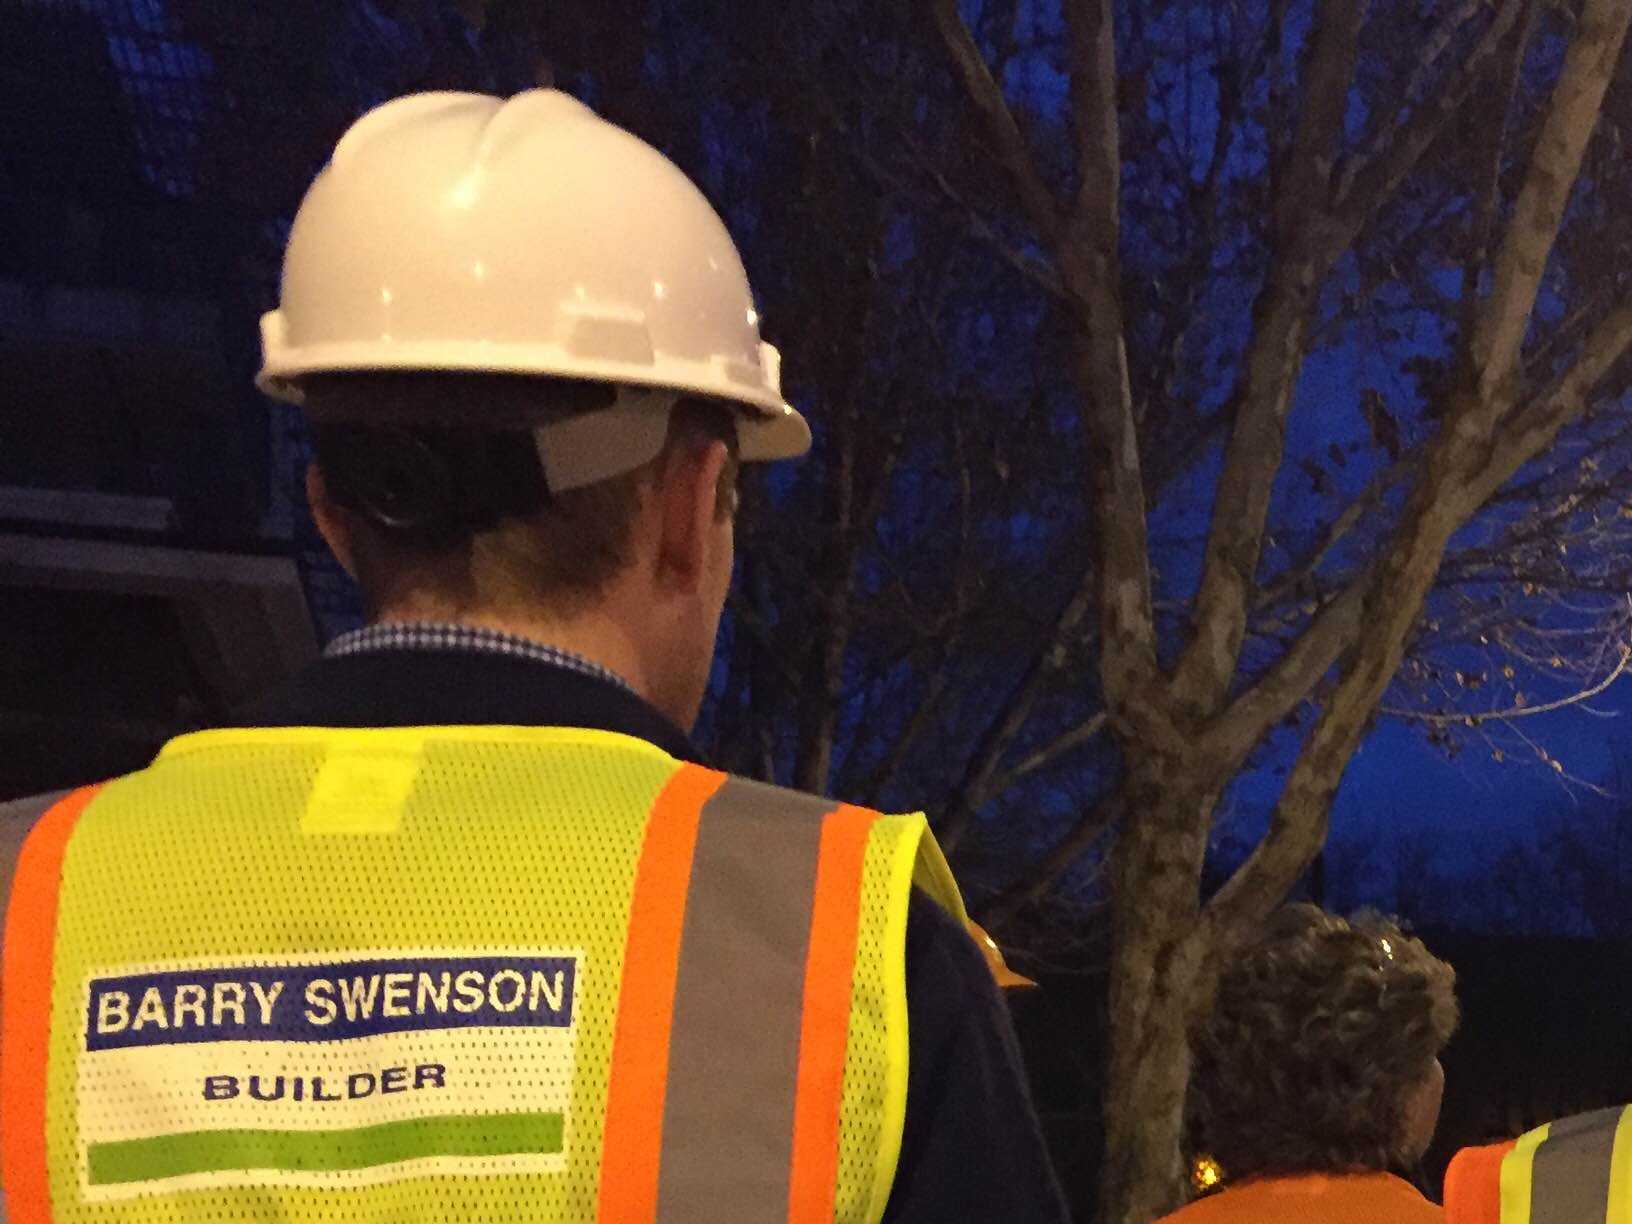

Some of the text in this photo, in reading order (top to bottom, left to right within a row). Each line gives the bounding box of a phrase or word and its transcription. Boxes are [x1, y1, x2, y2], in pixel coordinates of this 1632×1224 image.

[96, 968, 565, 1034] BARRY SWENSON
[202, 1062, 447, 1102] BUILDER
